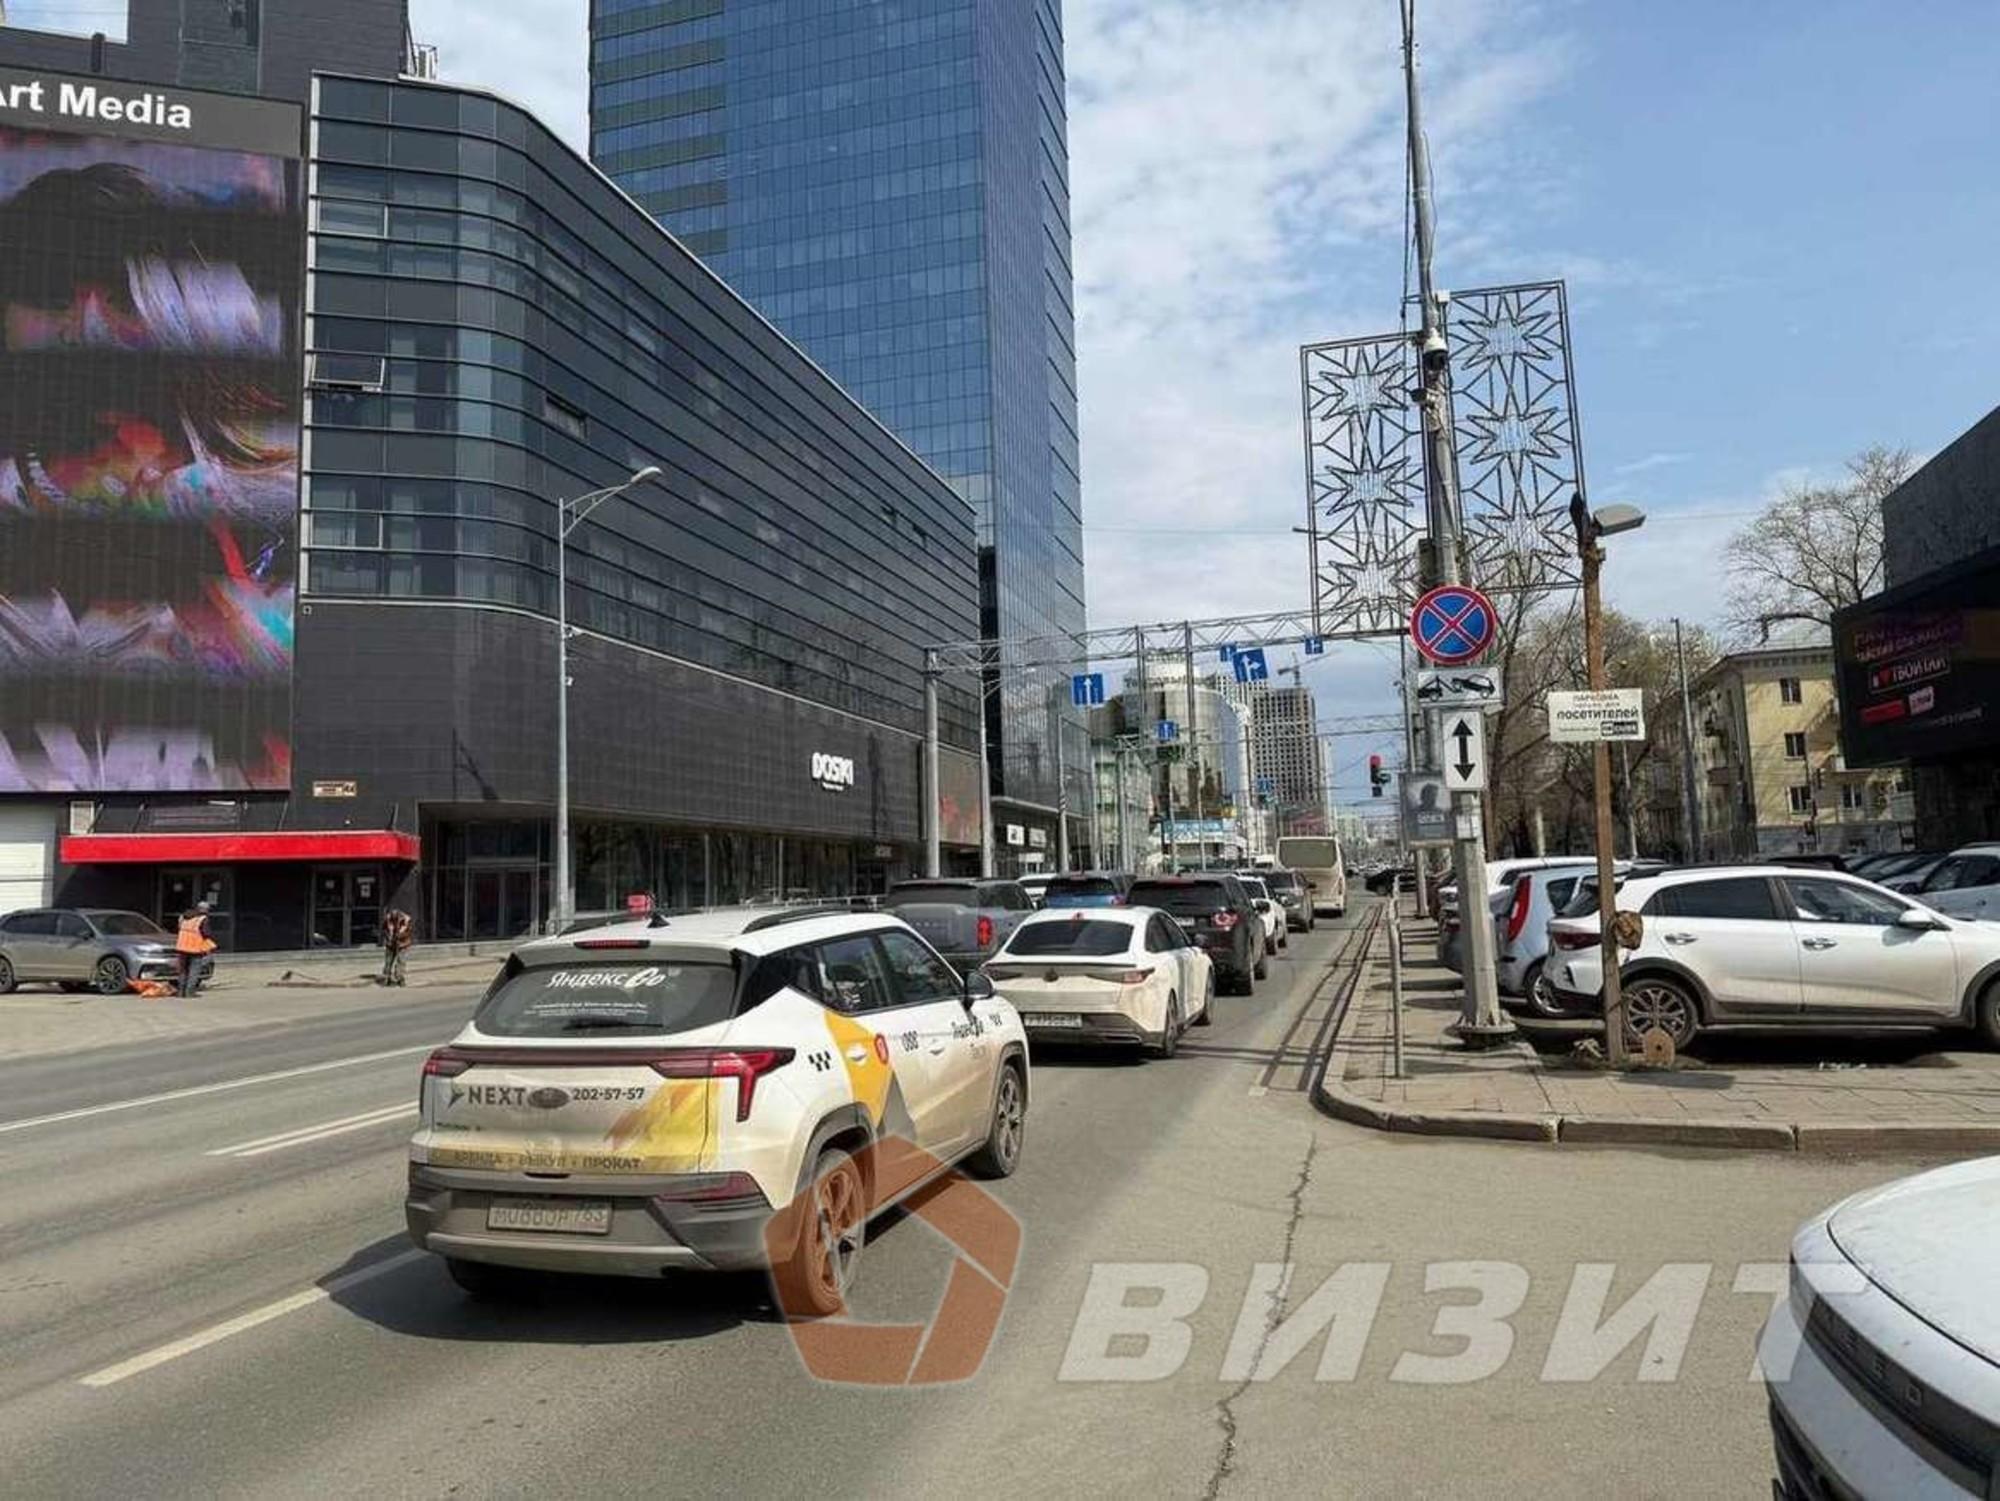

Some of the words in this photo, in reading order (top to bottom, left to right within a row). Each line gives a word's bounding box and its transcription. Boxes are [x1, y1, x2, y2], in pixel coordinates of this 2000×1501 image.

[0, 81, 44, 112] rt
[59, 83, 192, 129] Media
[547, 971, 628, 988] Яндекс
[468, 1086, 526, 1105] NEXT
[573, 1087, 645, 1101] 202-57-57
[583, 1157, 641, 1169] ПРОКАТ
